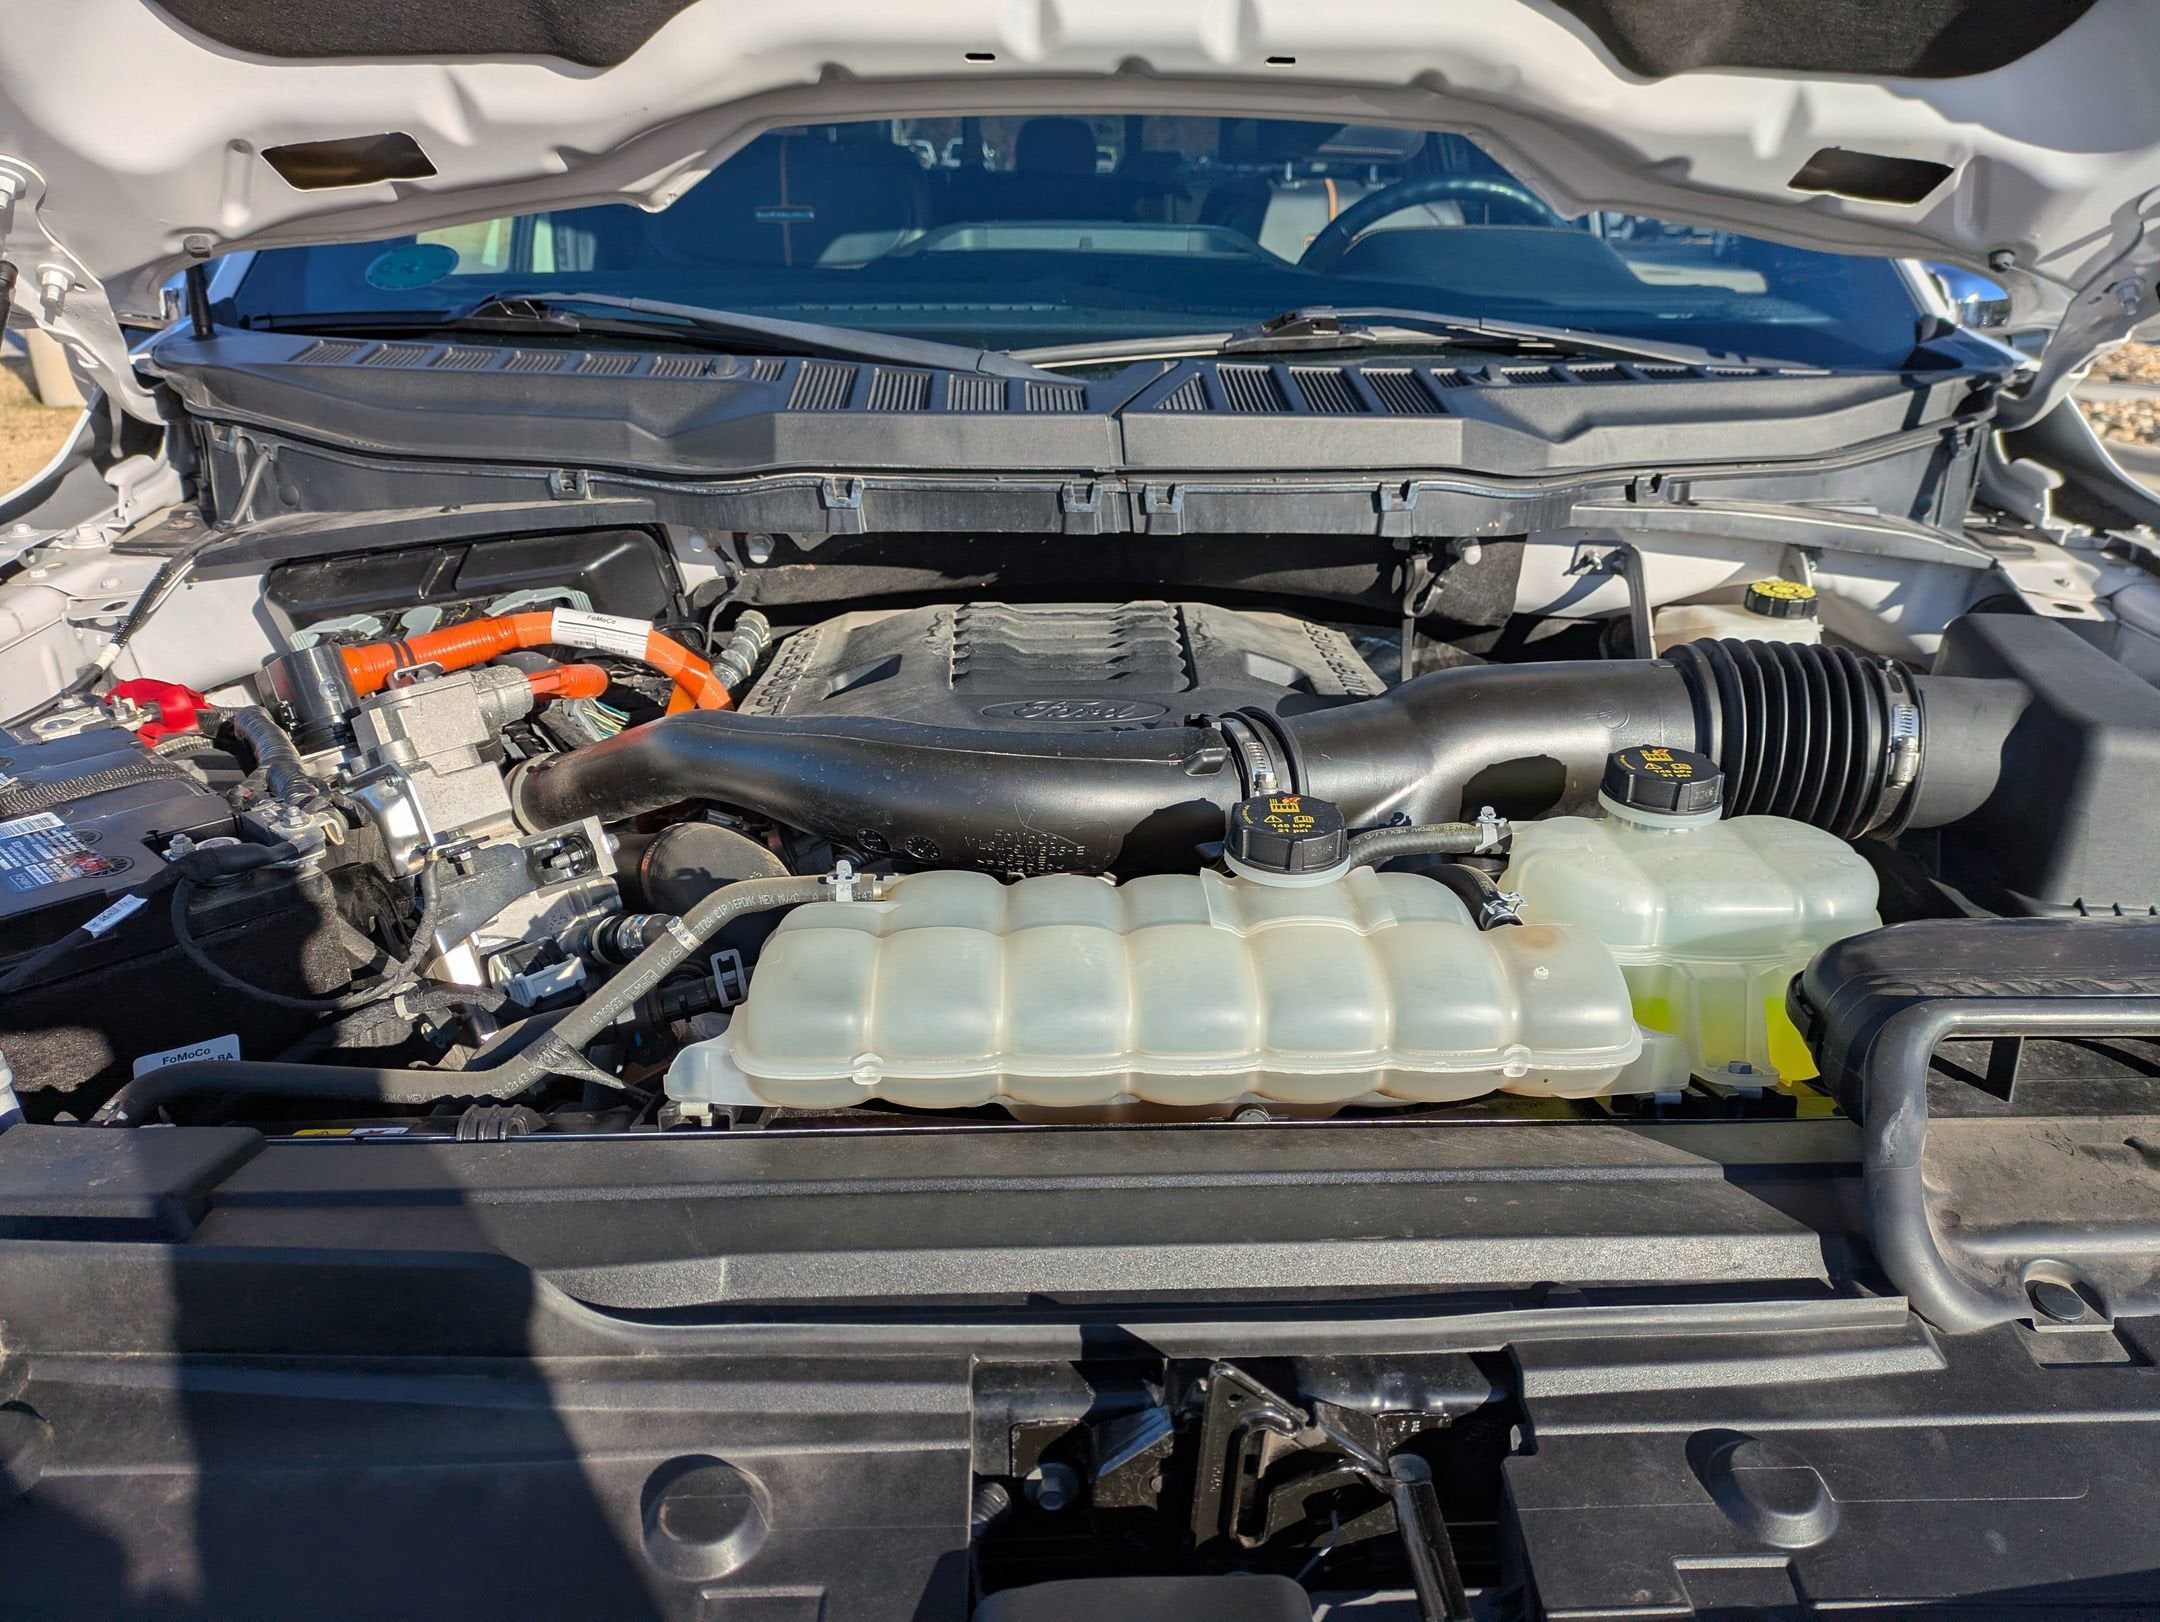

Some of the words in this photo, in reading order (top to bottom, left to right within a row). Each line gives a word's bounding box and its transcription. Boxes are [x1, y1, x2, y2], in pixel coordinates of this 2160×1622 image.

[586, 614, 617, 625] FoMoCo
[1013, 700, 1138, 719] Ford
[162, 1047, 211, 1065] FoMoCo
